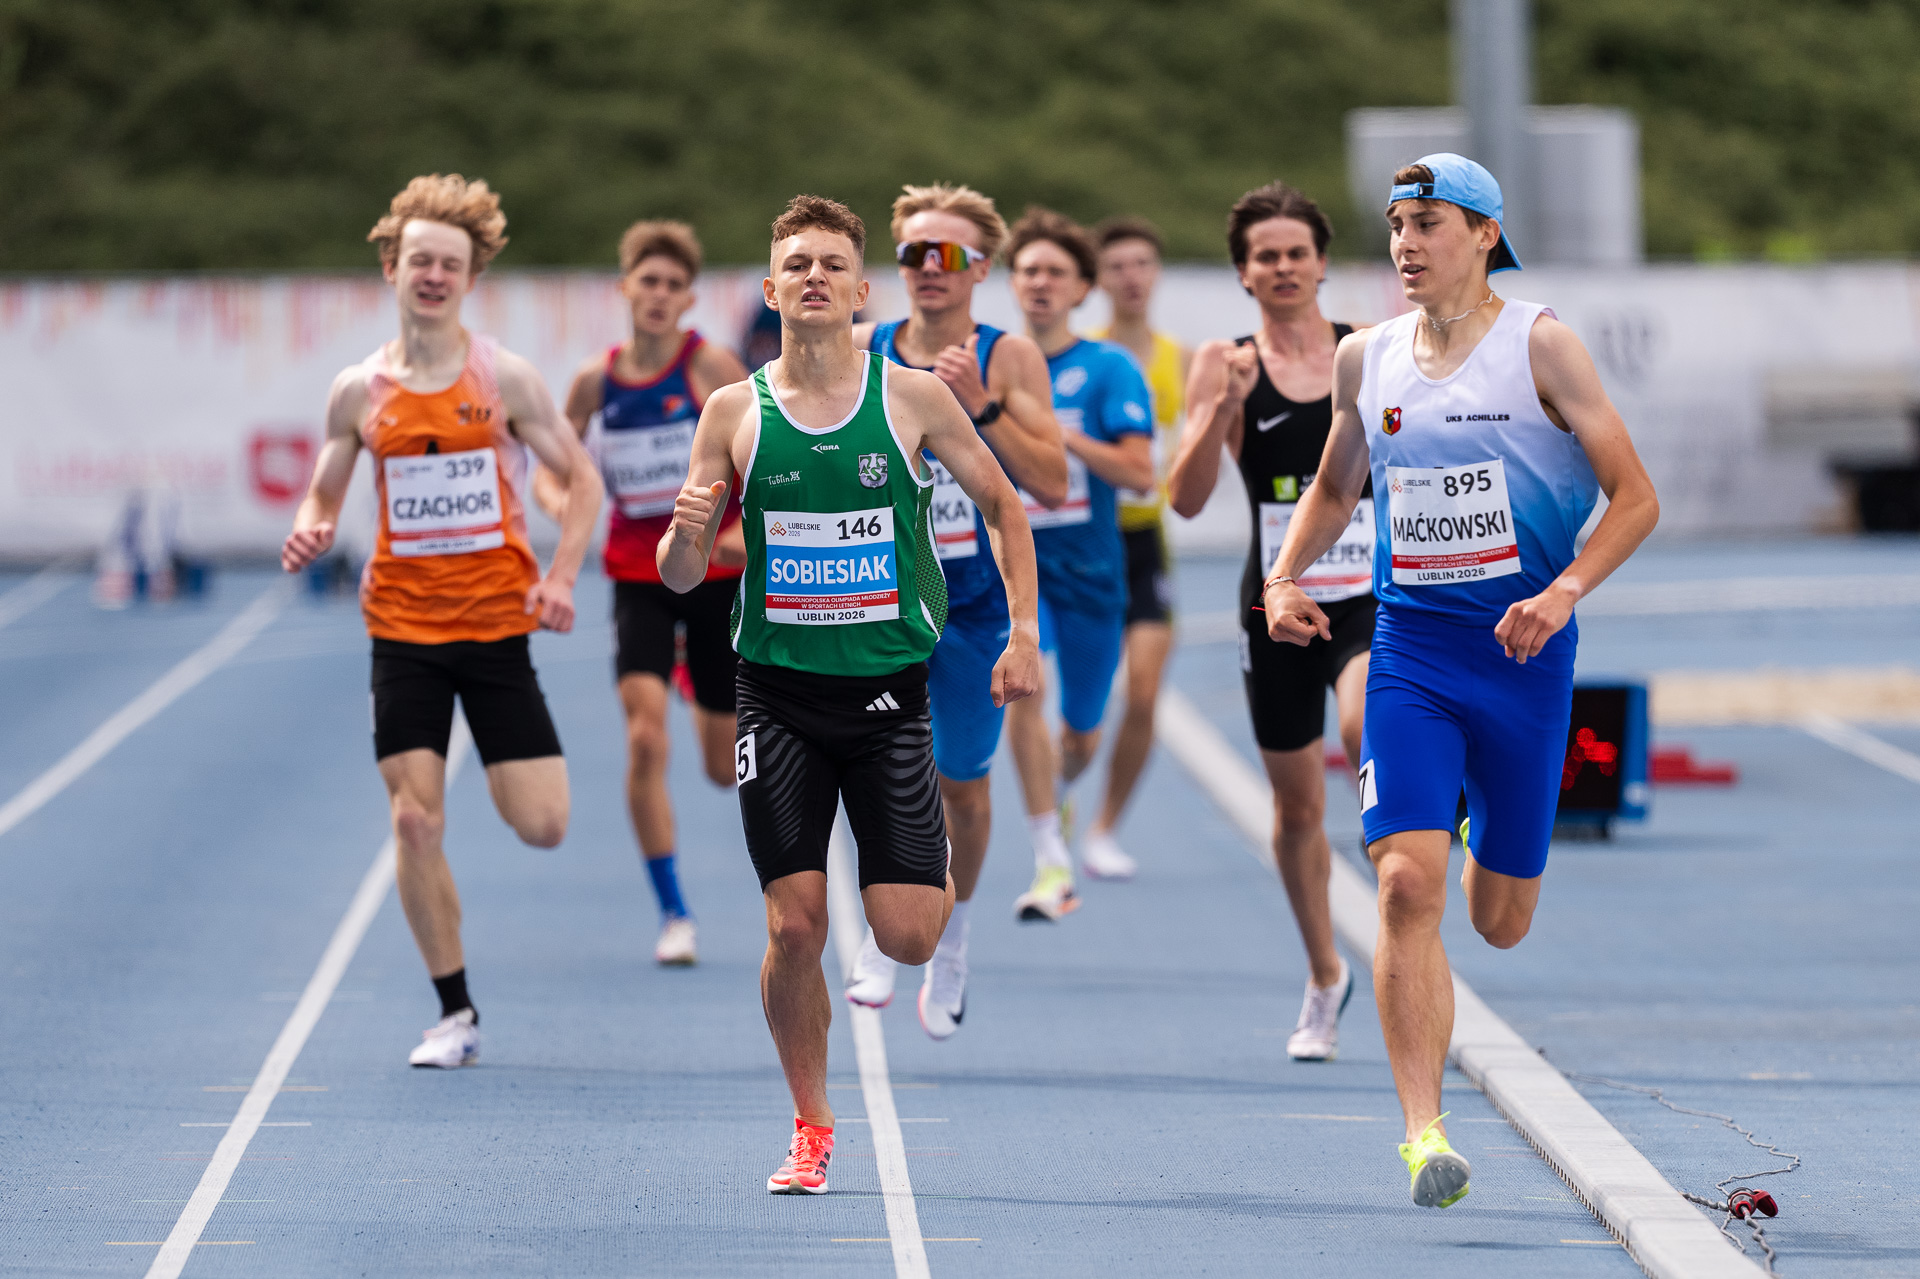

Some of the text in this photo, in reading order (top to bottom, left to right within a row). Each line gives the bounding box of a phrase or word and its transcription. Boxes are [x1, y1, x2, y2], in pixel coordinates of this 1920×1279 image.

[445, 456, 485, 479] 339
[1403, 479, 1432, 487] LUBELSKIE
[1443, 469, 1492, 497] 895
[393, 490, 494, 519] CZACHOR
[788, 522, 821, 531] LUBELSKIE
[836, 515, 882, 540] 146
[1393, 510, 1507, 543] MAĆKOWSKI
[770, 554, 891, 585] SOBIESIAK
[1417, 567, 1486, 581] LUBLIN 2026
[797, 610, 866, 621] LUBLIN 2026
[738, 739, 750, 780] 5
